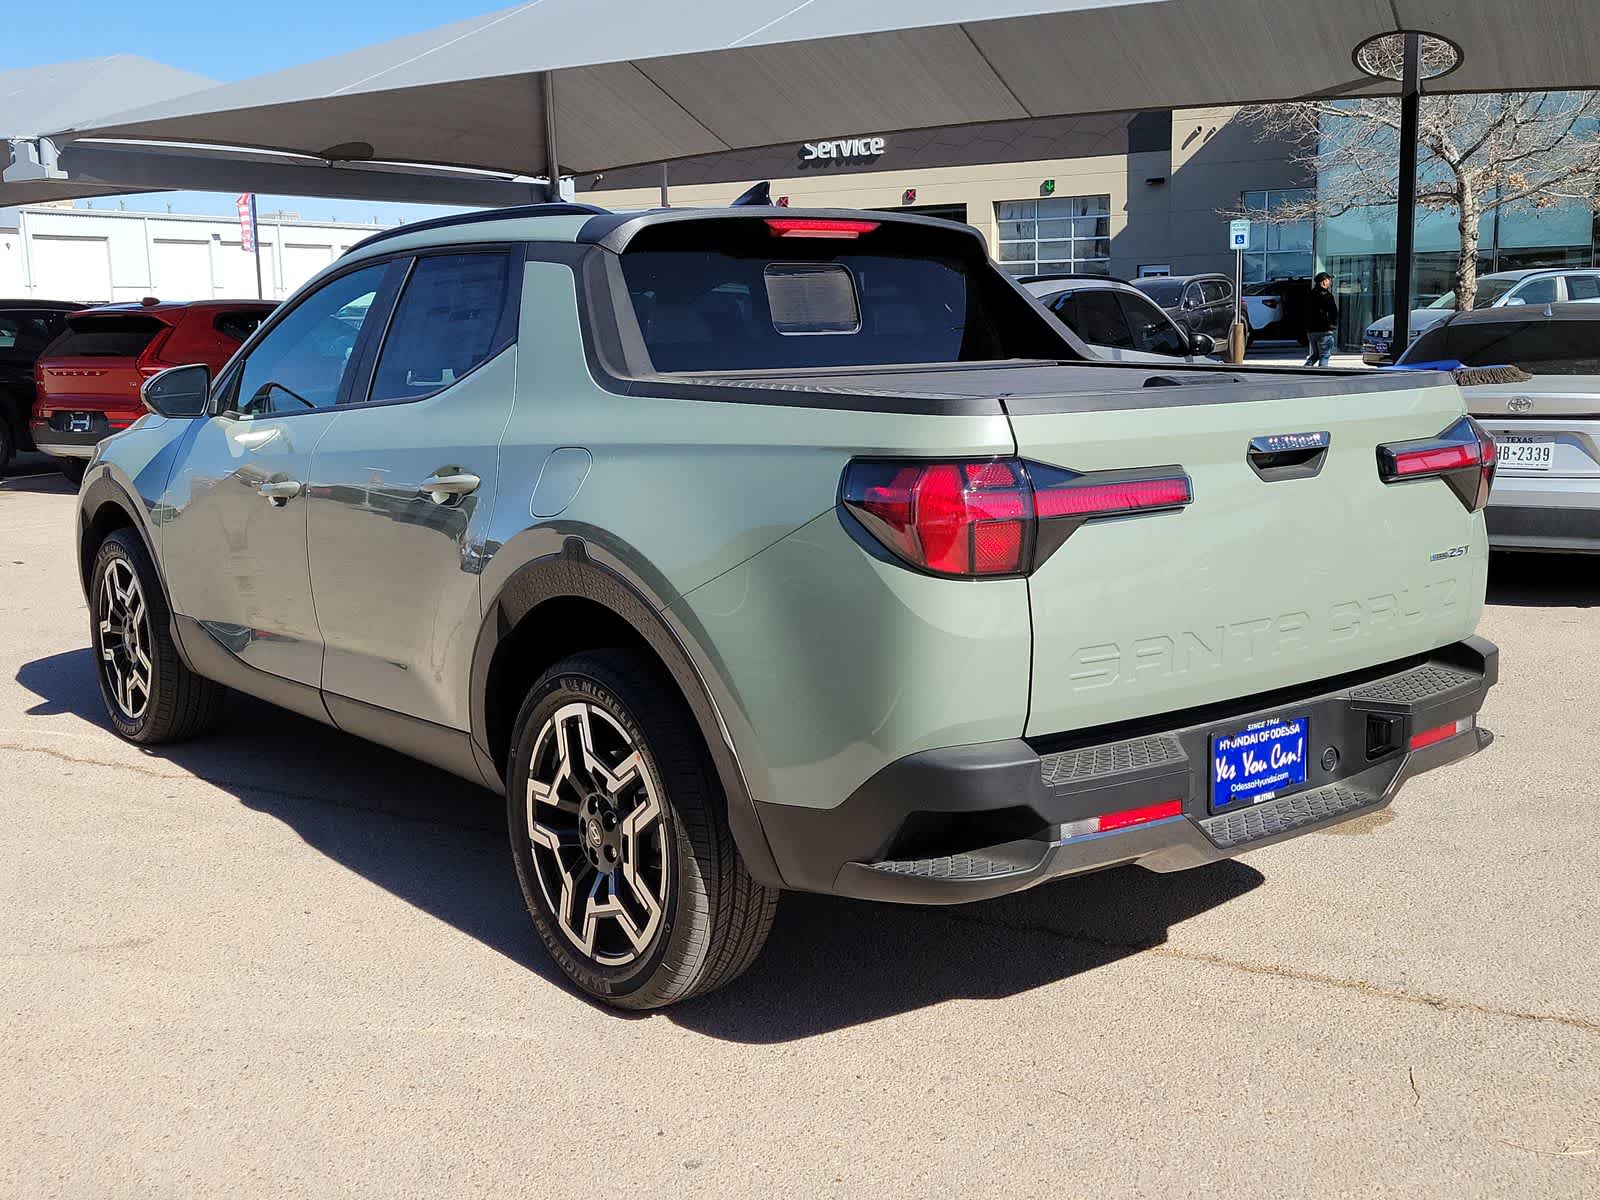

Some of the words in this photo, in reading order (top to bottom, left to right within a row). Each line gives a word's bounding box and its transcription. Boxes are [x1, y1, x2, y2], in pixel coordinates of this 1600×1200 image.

[803, 137, 885, 160] Service
[1506, 435, 1533, 444] TEXAS
[1068, 609, 1311, 693] SANTA
[1328, 577, 1458, 643] CRUZ
[1219, 734, 1258, 751] HYUNDAI
[1259, 729, 1270, 742] OF
[1270, 723, 1300, 739] ODESSA
[1215, 755, 1237, 783] Yes
[1242, 750, 1268, 777] You
[1271, 737, 1303, 769] Can!
[1230, 772, 1289, 792] OdessaHyundai.com
